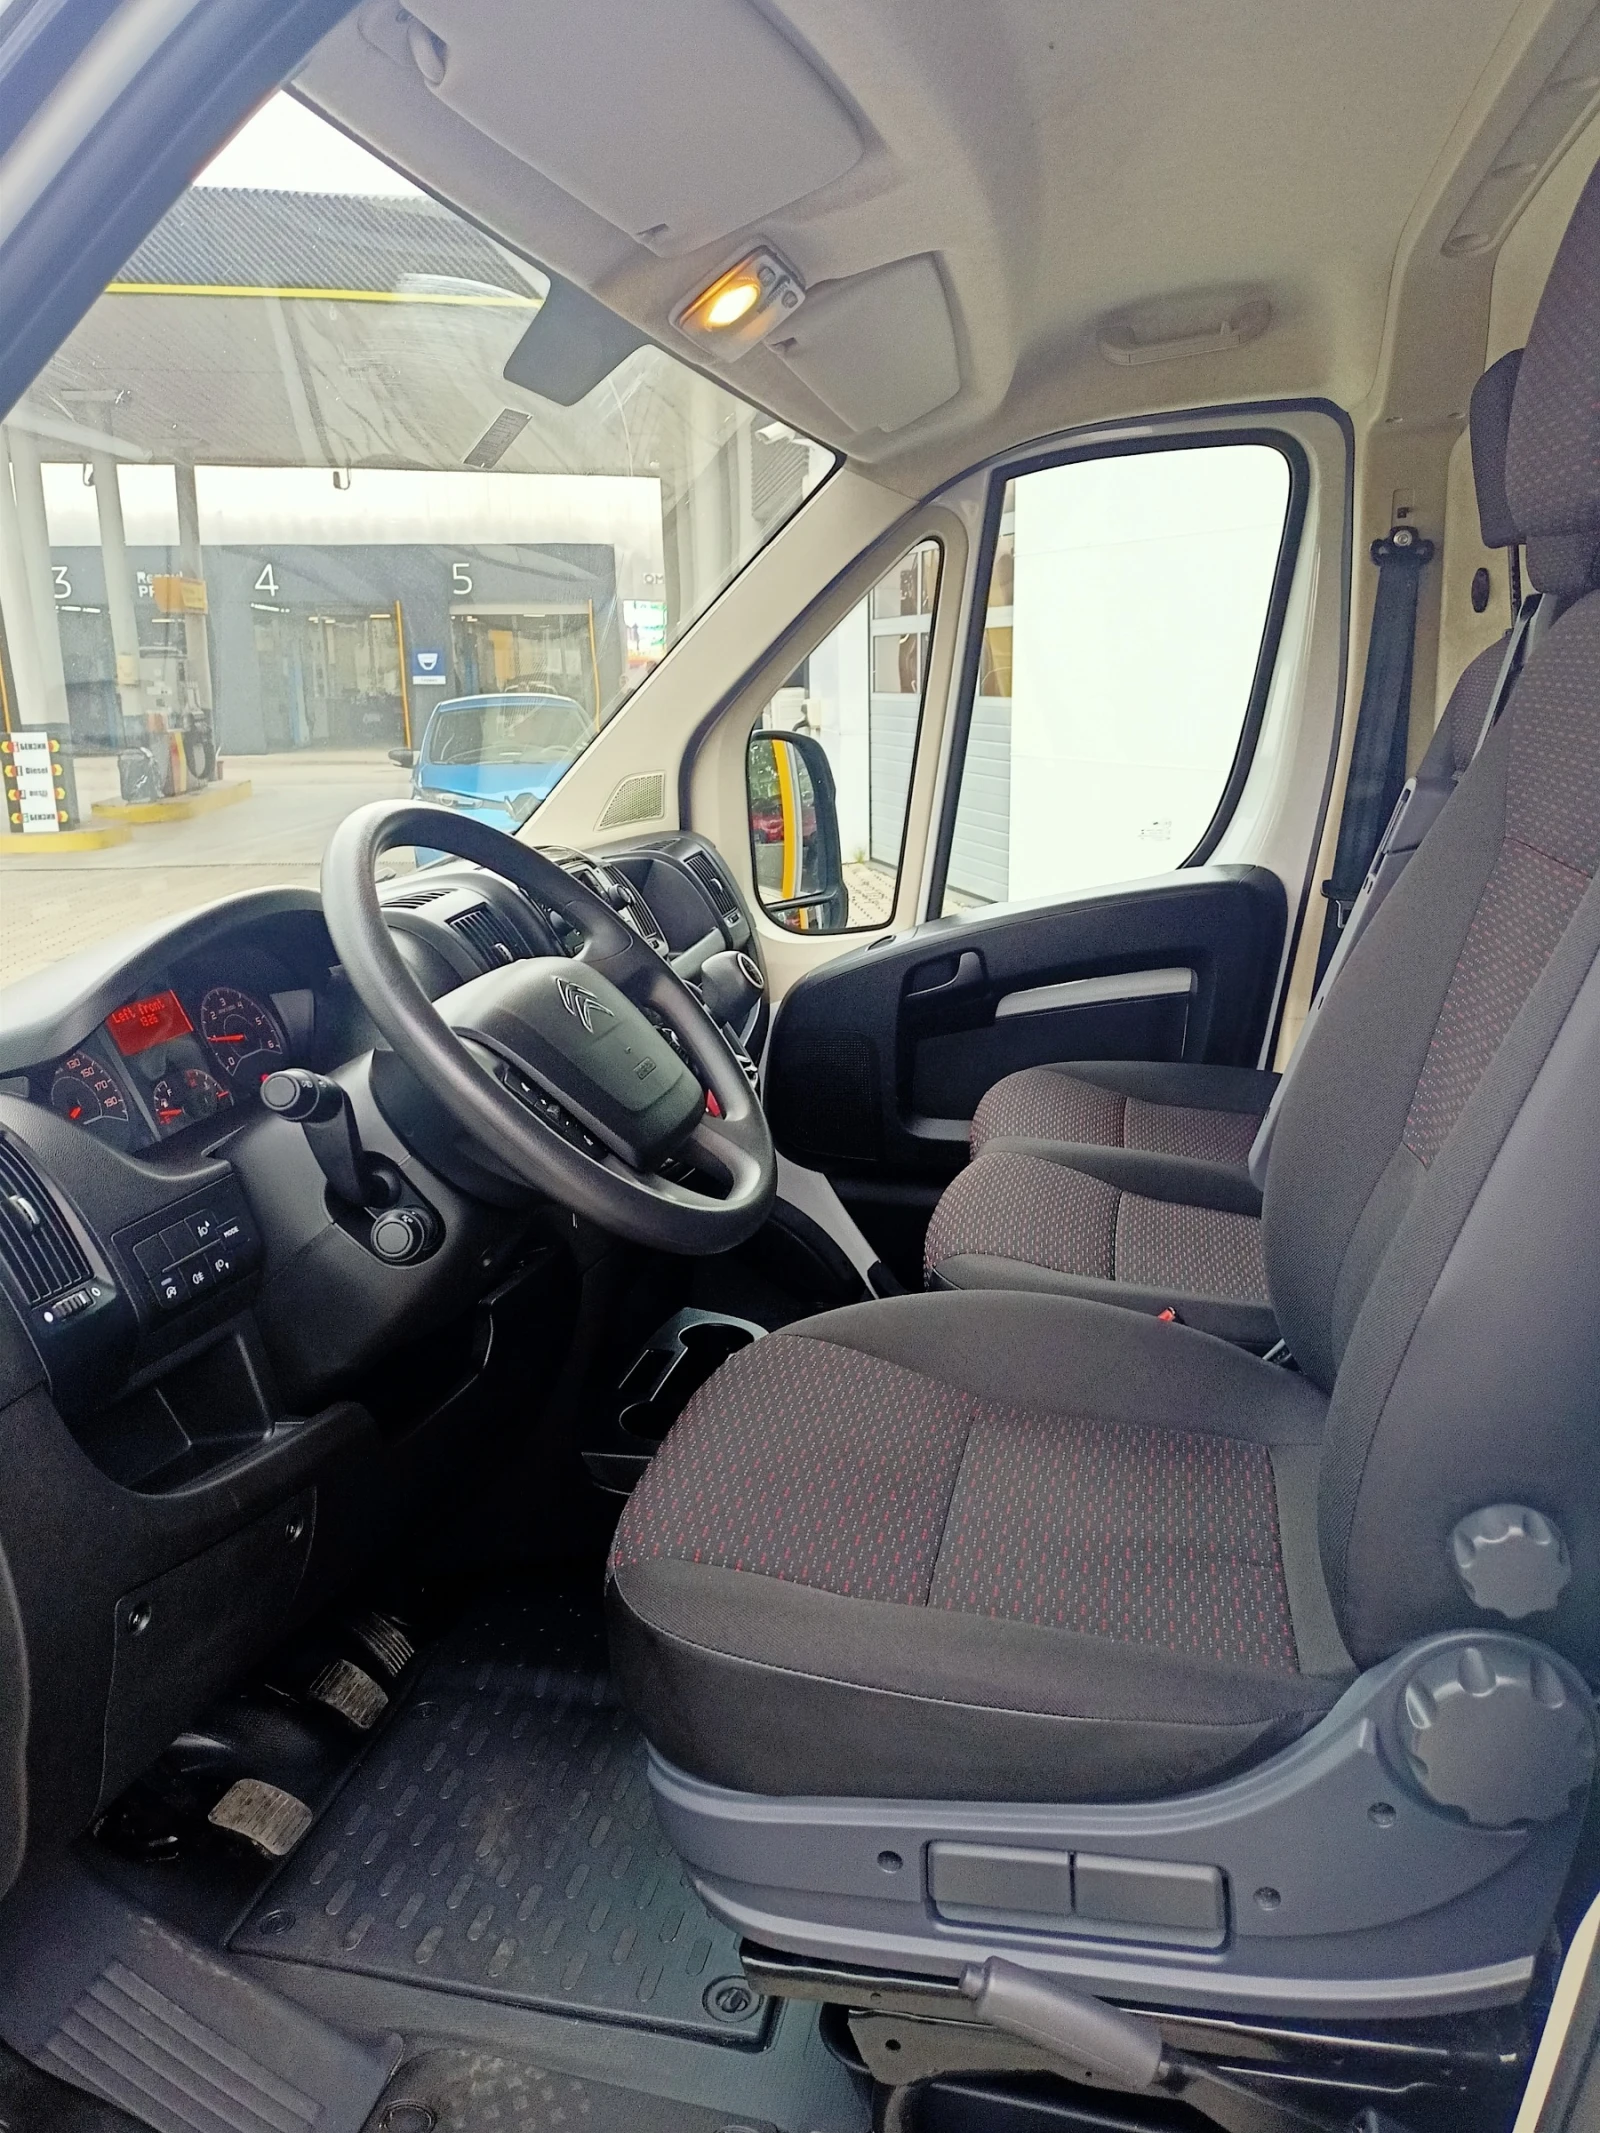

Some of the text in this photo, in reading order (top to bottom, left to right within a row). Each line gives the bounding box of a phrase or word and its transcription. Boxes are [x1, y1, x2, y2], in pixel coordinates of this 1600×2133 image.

[51, 566, 72, 599] 3
[255, 563, 279, 597] 4
[452, 563, 473, 595] 5
[219, 997, 227, 1007] 3
[111, 998, 166, 1024] Left front
[210, 1011, 217, 1020] 2
[254, 1016, 262, 1026] 5
[267, 1040, 275, 1049] 6
[66, 1058, 81, 1070] 130
[228, 1056, 235, 1066] 0
[80, 1066, 95, 1078] 150
[94, 1080, 108, 1091] 170
[103, 1096, 118, 1108] 190
[223, 1225, 240, 1238] MODE
